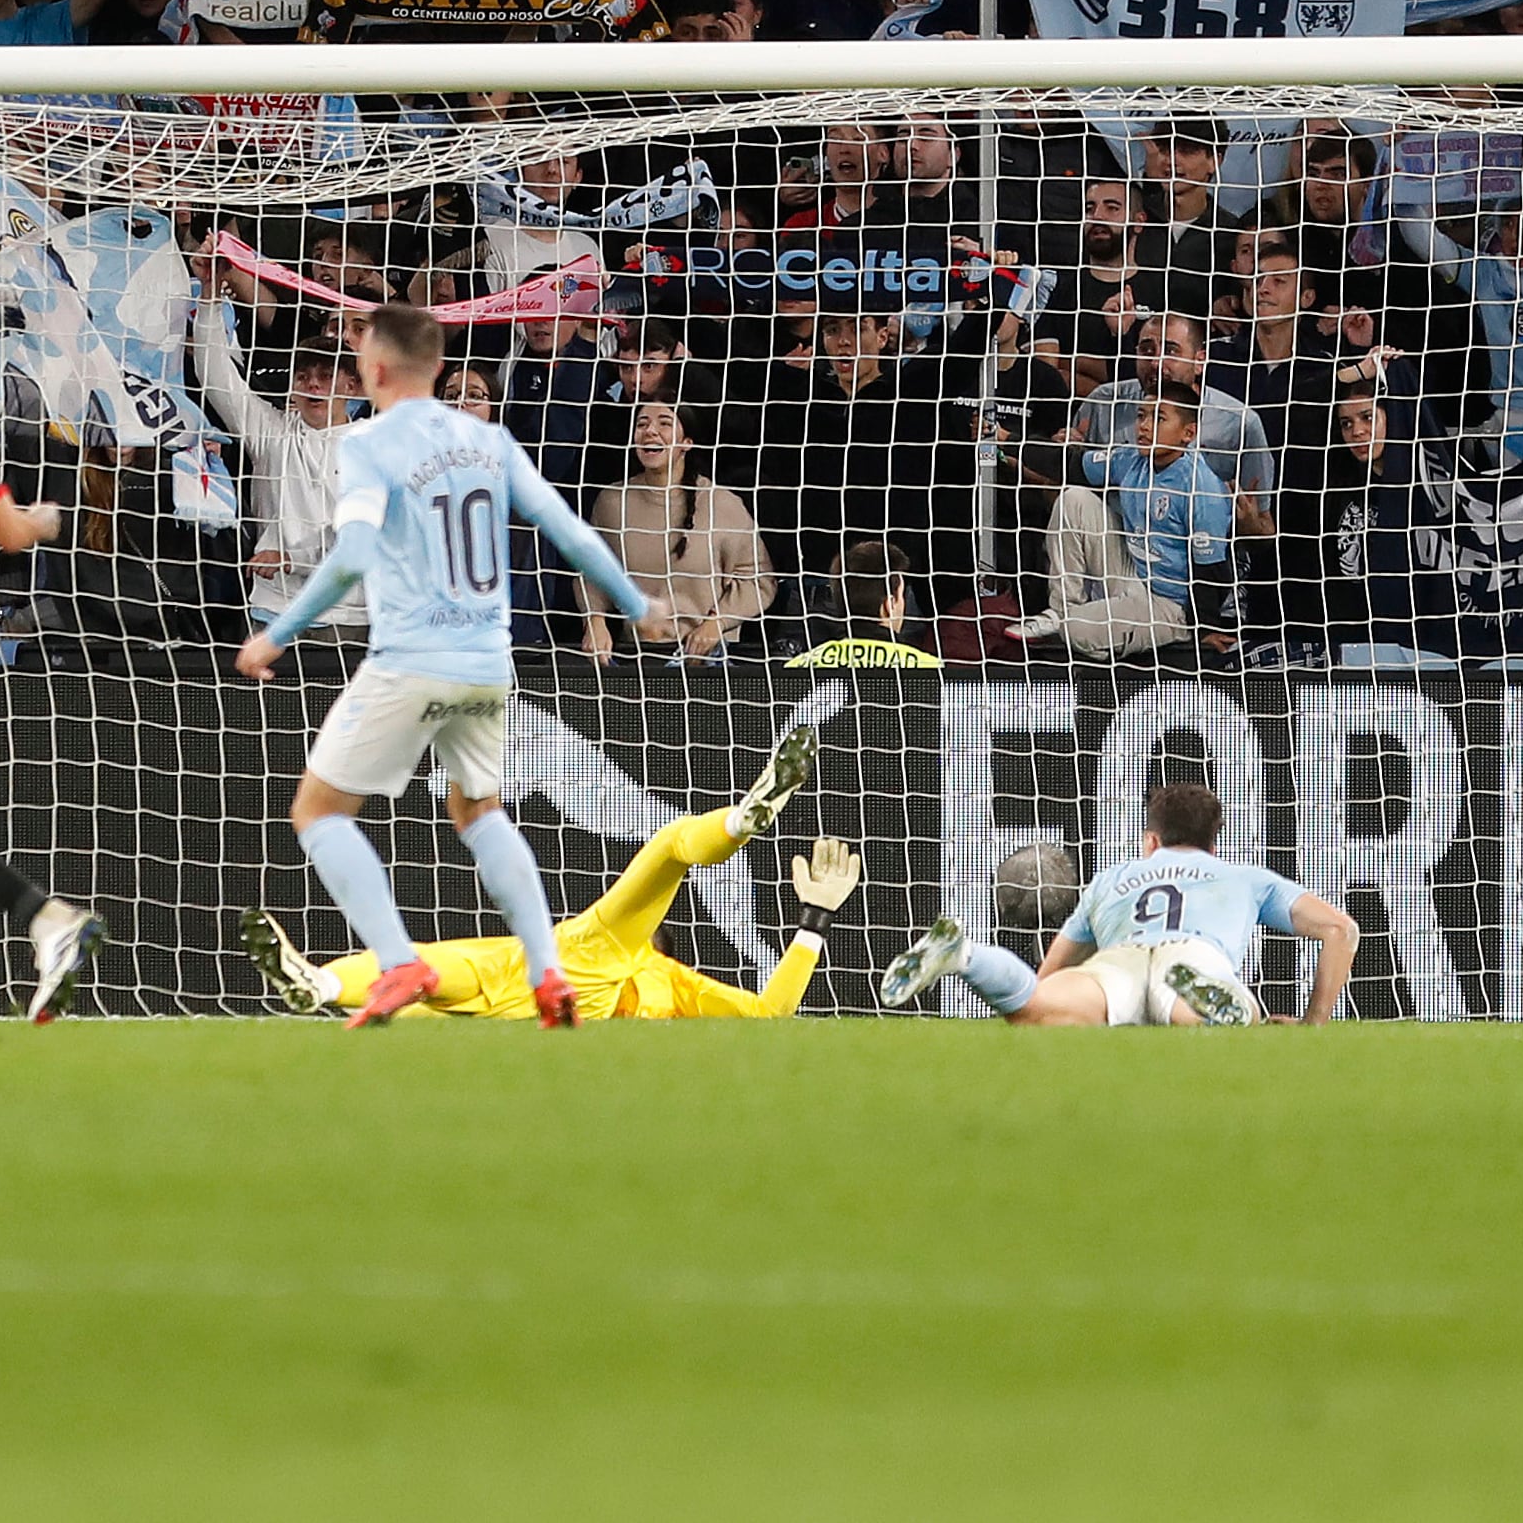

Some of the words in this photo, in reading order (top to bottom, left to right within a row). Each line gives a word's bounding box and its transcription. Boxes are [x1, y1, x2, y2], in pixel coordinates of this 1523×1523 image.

[688, 247, 943, 295] RCCelta
[432, 488, 500, 600] 10
[799, 639, 921, 670] GURIDAD
[1134, 882, 1186, 934] 9
